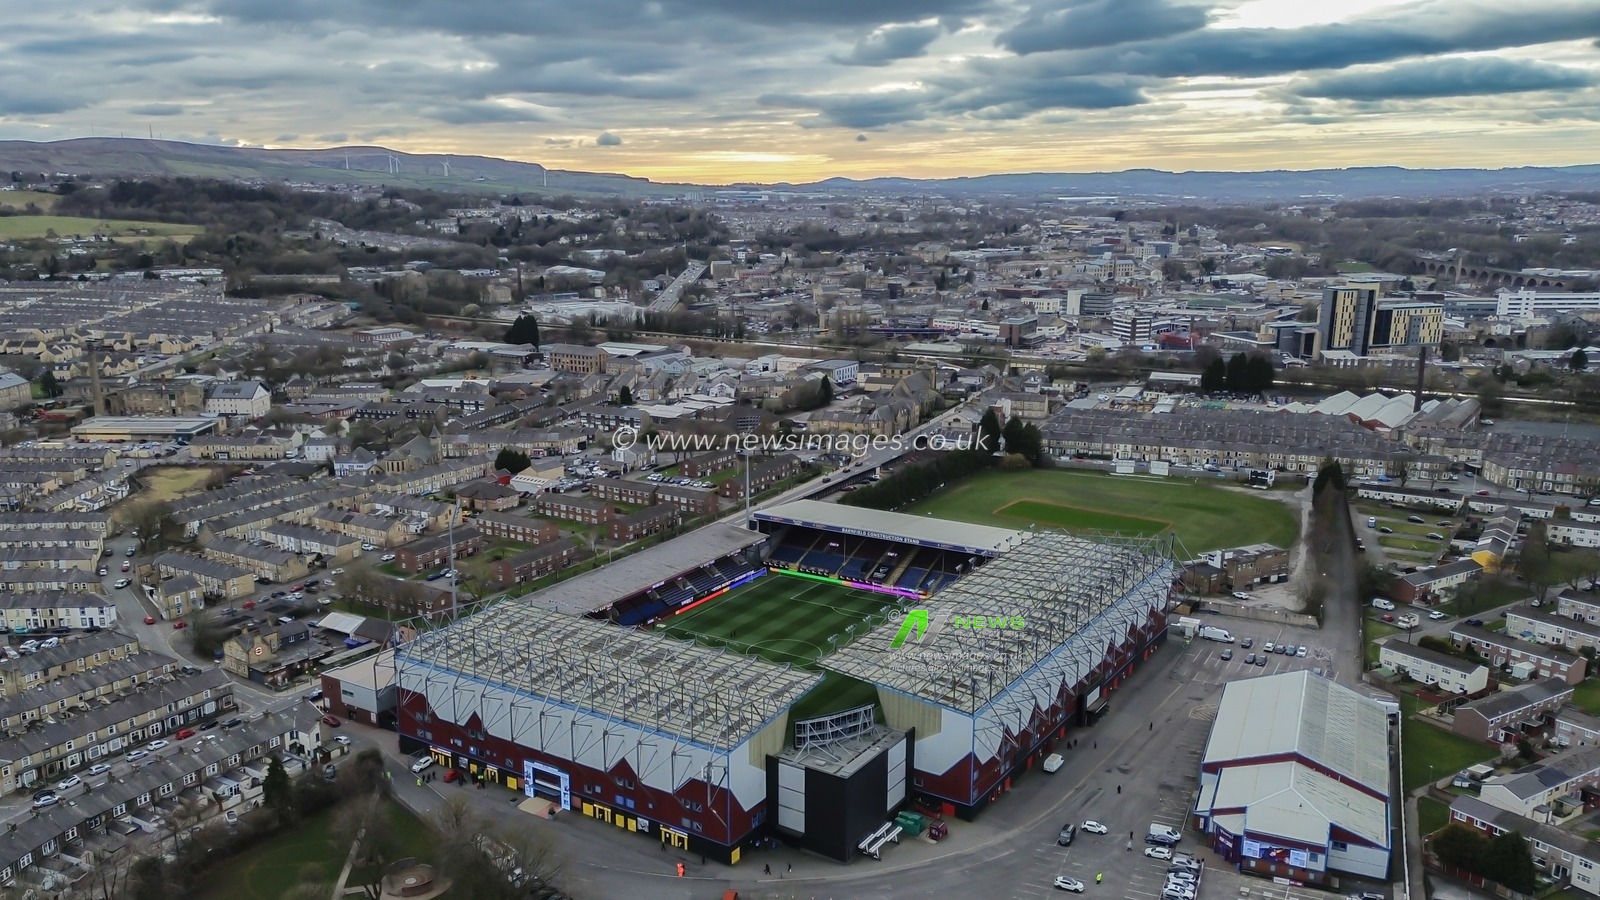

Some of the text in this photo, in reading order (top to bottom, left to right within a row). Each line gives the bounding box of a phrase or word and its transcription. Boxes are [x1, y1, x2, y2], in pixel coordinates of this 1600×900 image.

[841, 527, 920, 545] BARNFIELD CONSTRUCTION STAND
